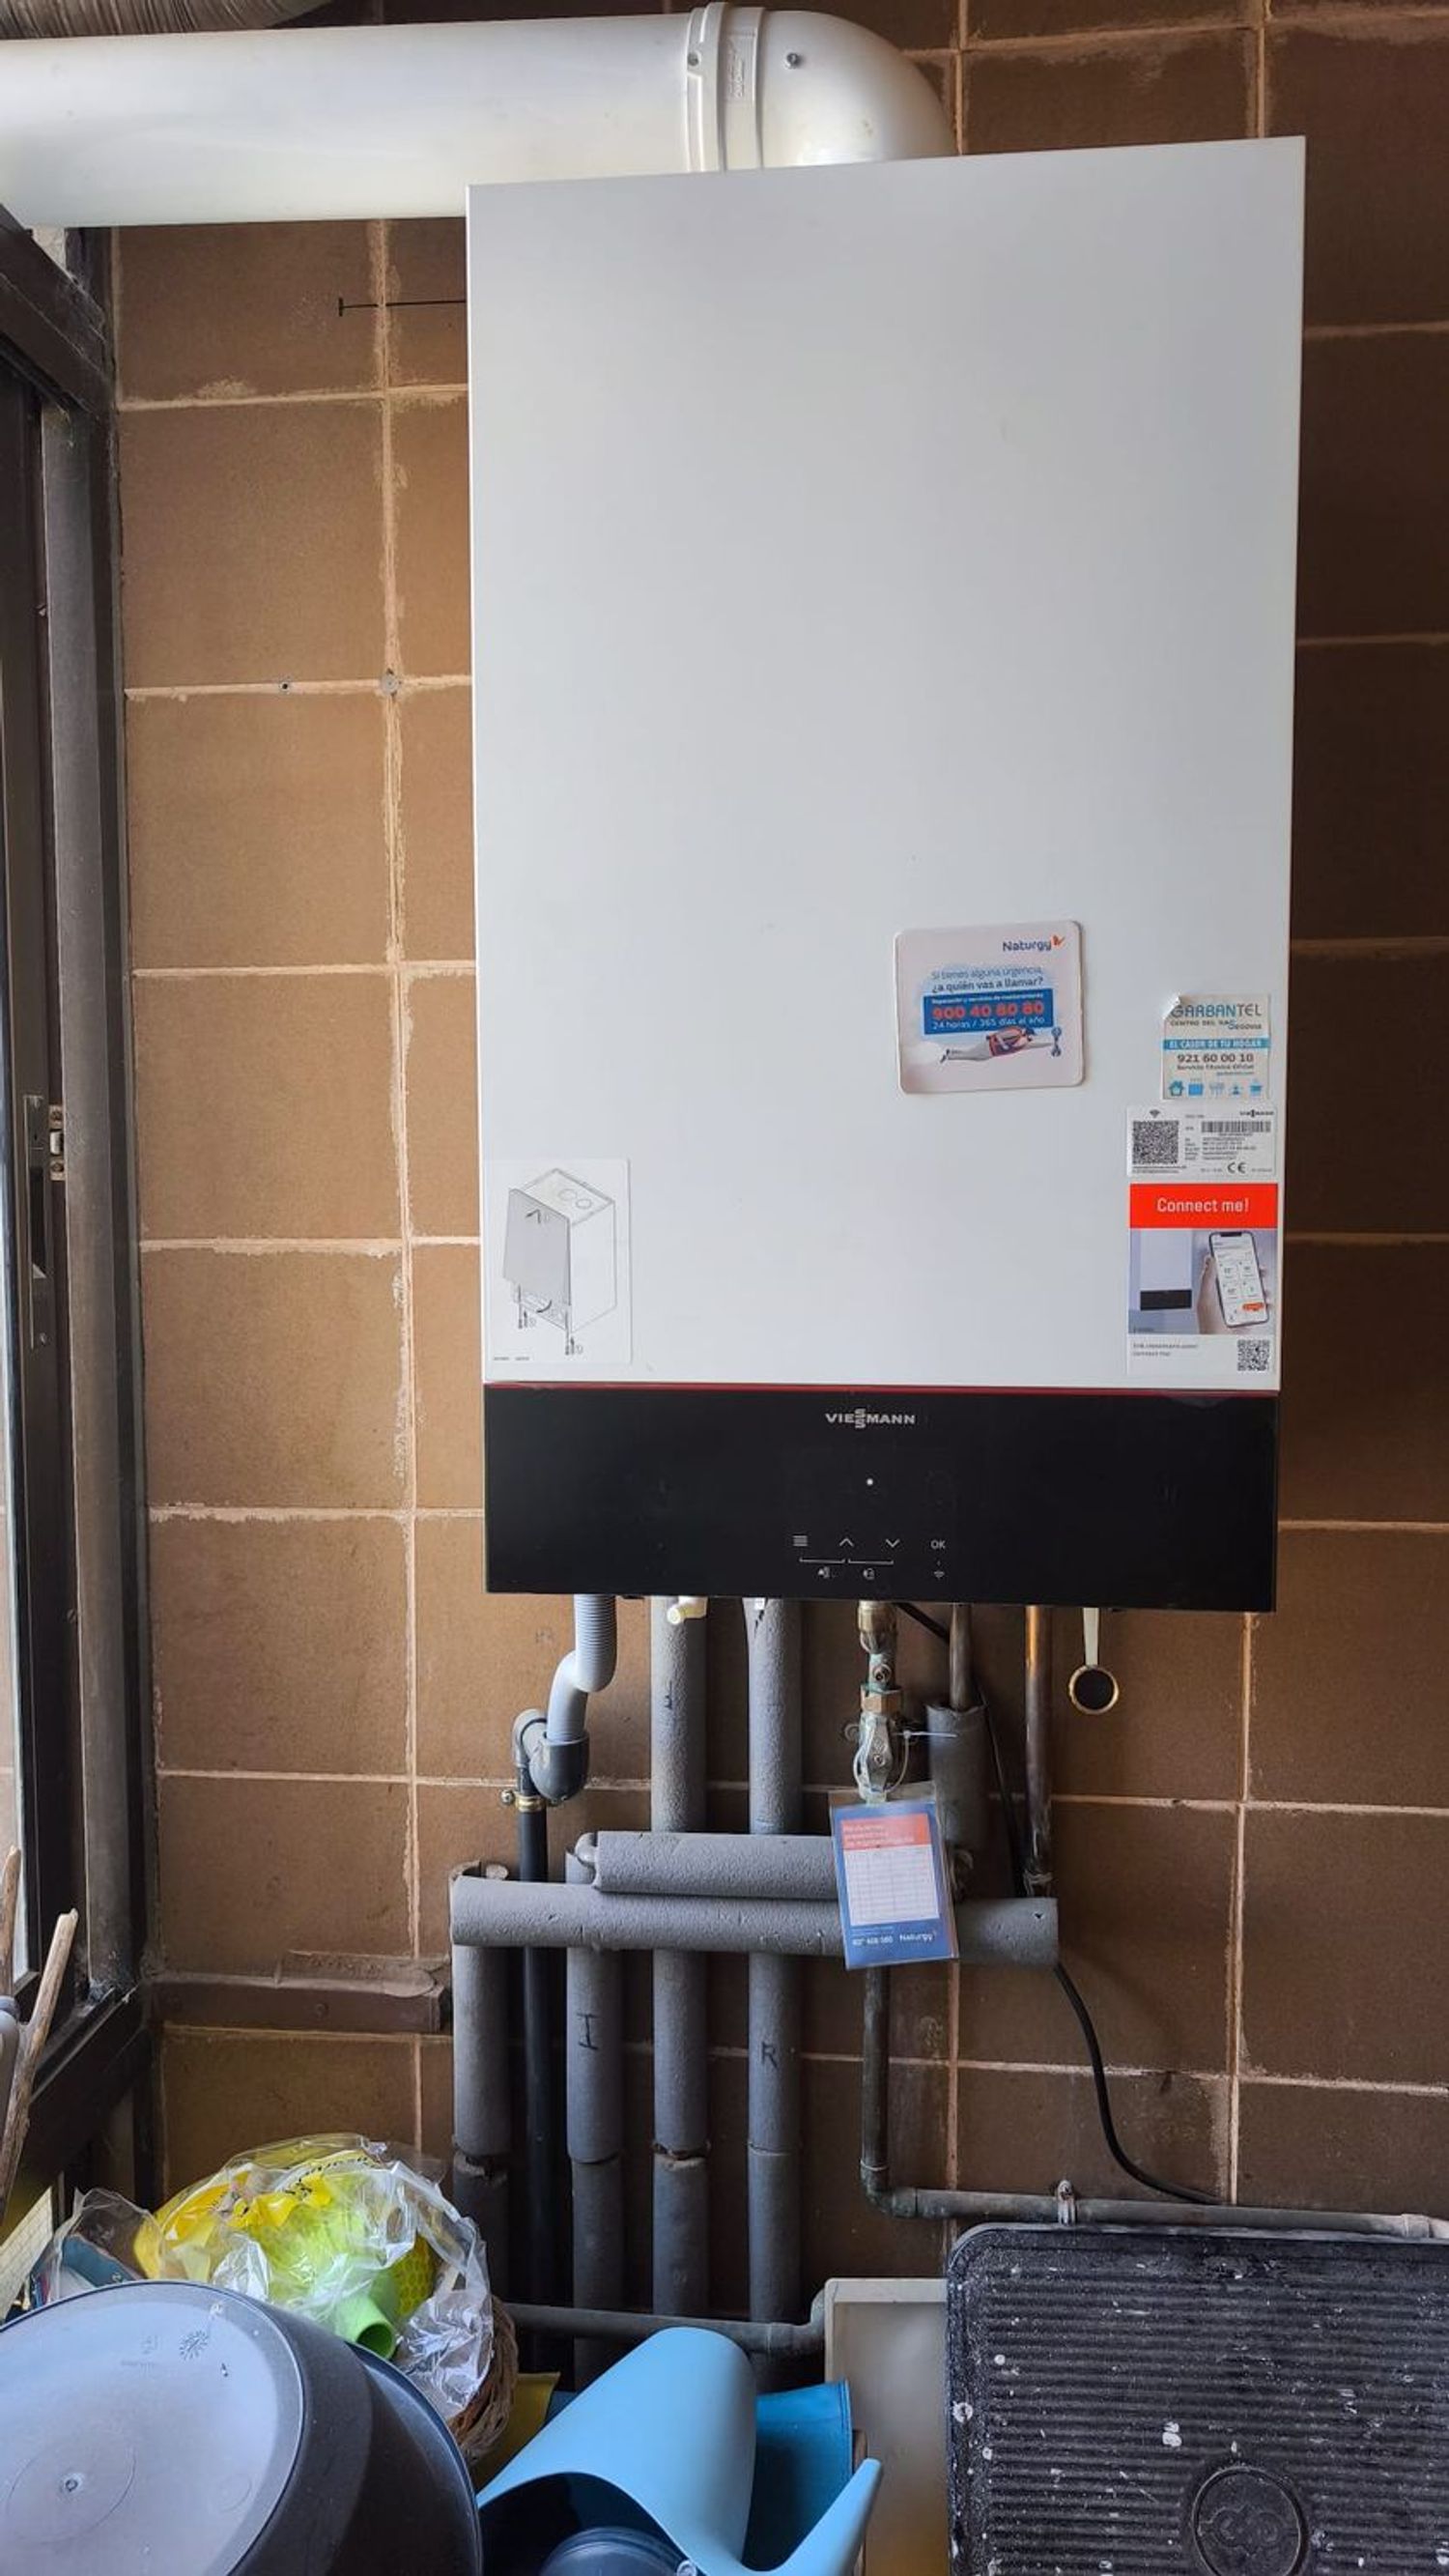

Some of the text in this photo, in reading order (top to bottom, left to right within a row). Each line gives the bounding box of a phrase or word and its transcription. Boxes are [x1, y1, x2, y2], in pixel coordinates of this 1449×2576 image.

[1002, 940, 1052, 952] Naturgy
[971, 967, 1001, 980] alguna
[932, 984, 944, 993] ¿a
[946, 981, 975, 992] quién
[1005, 976, 1043, 987] llamar?
[970, 1004, 992, 1017] 40
[1170, 1004, 1263, 1017] GARBANTEL
[932, 1021, 944, 1030] 24
[946, 1020, 971, 1029] horas
[979, 1017, 997, 1027] 365
[1177, 1053, 1254, 1063] 921 60 00 10
[1156, 1197, 1249, 1213] Connect me!
[825, 1408, 916, 1429] VIESSMANN
[930, 1539, 946, 1549] OK
